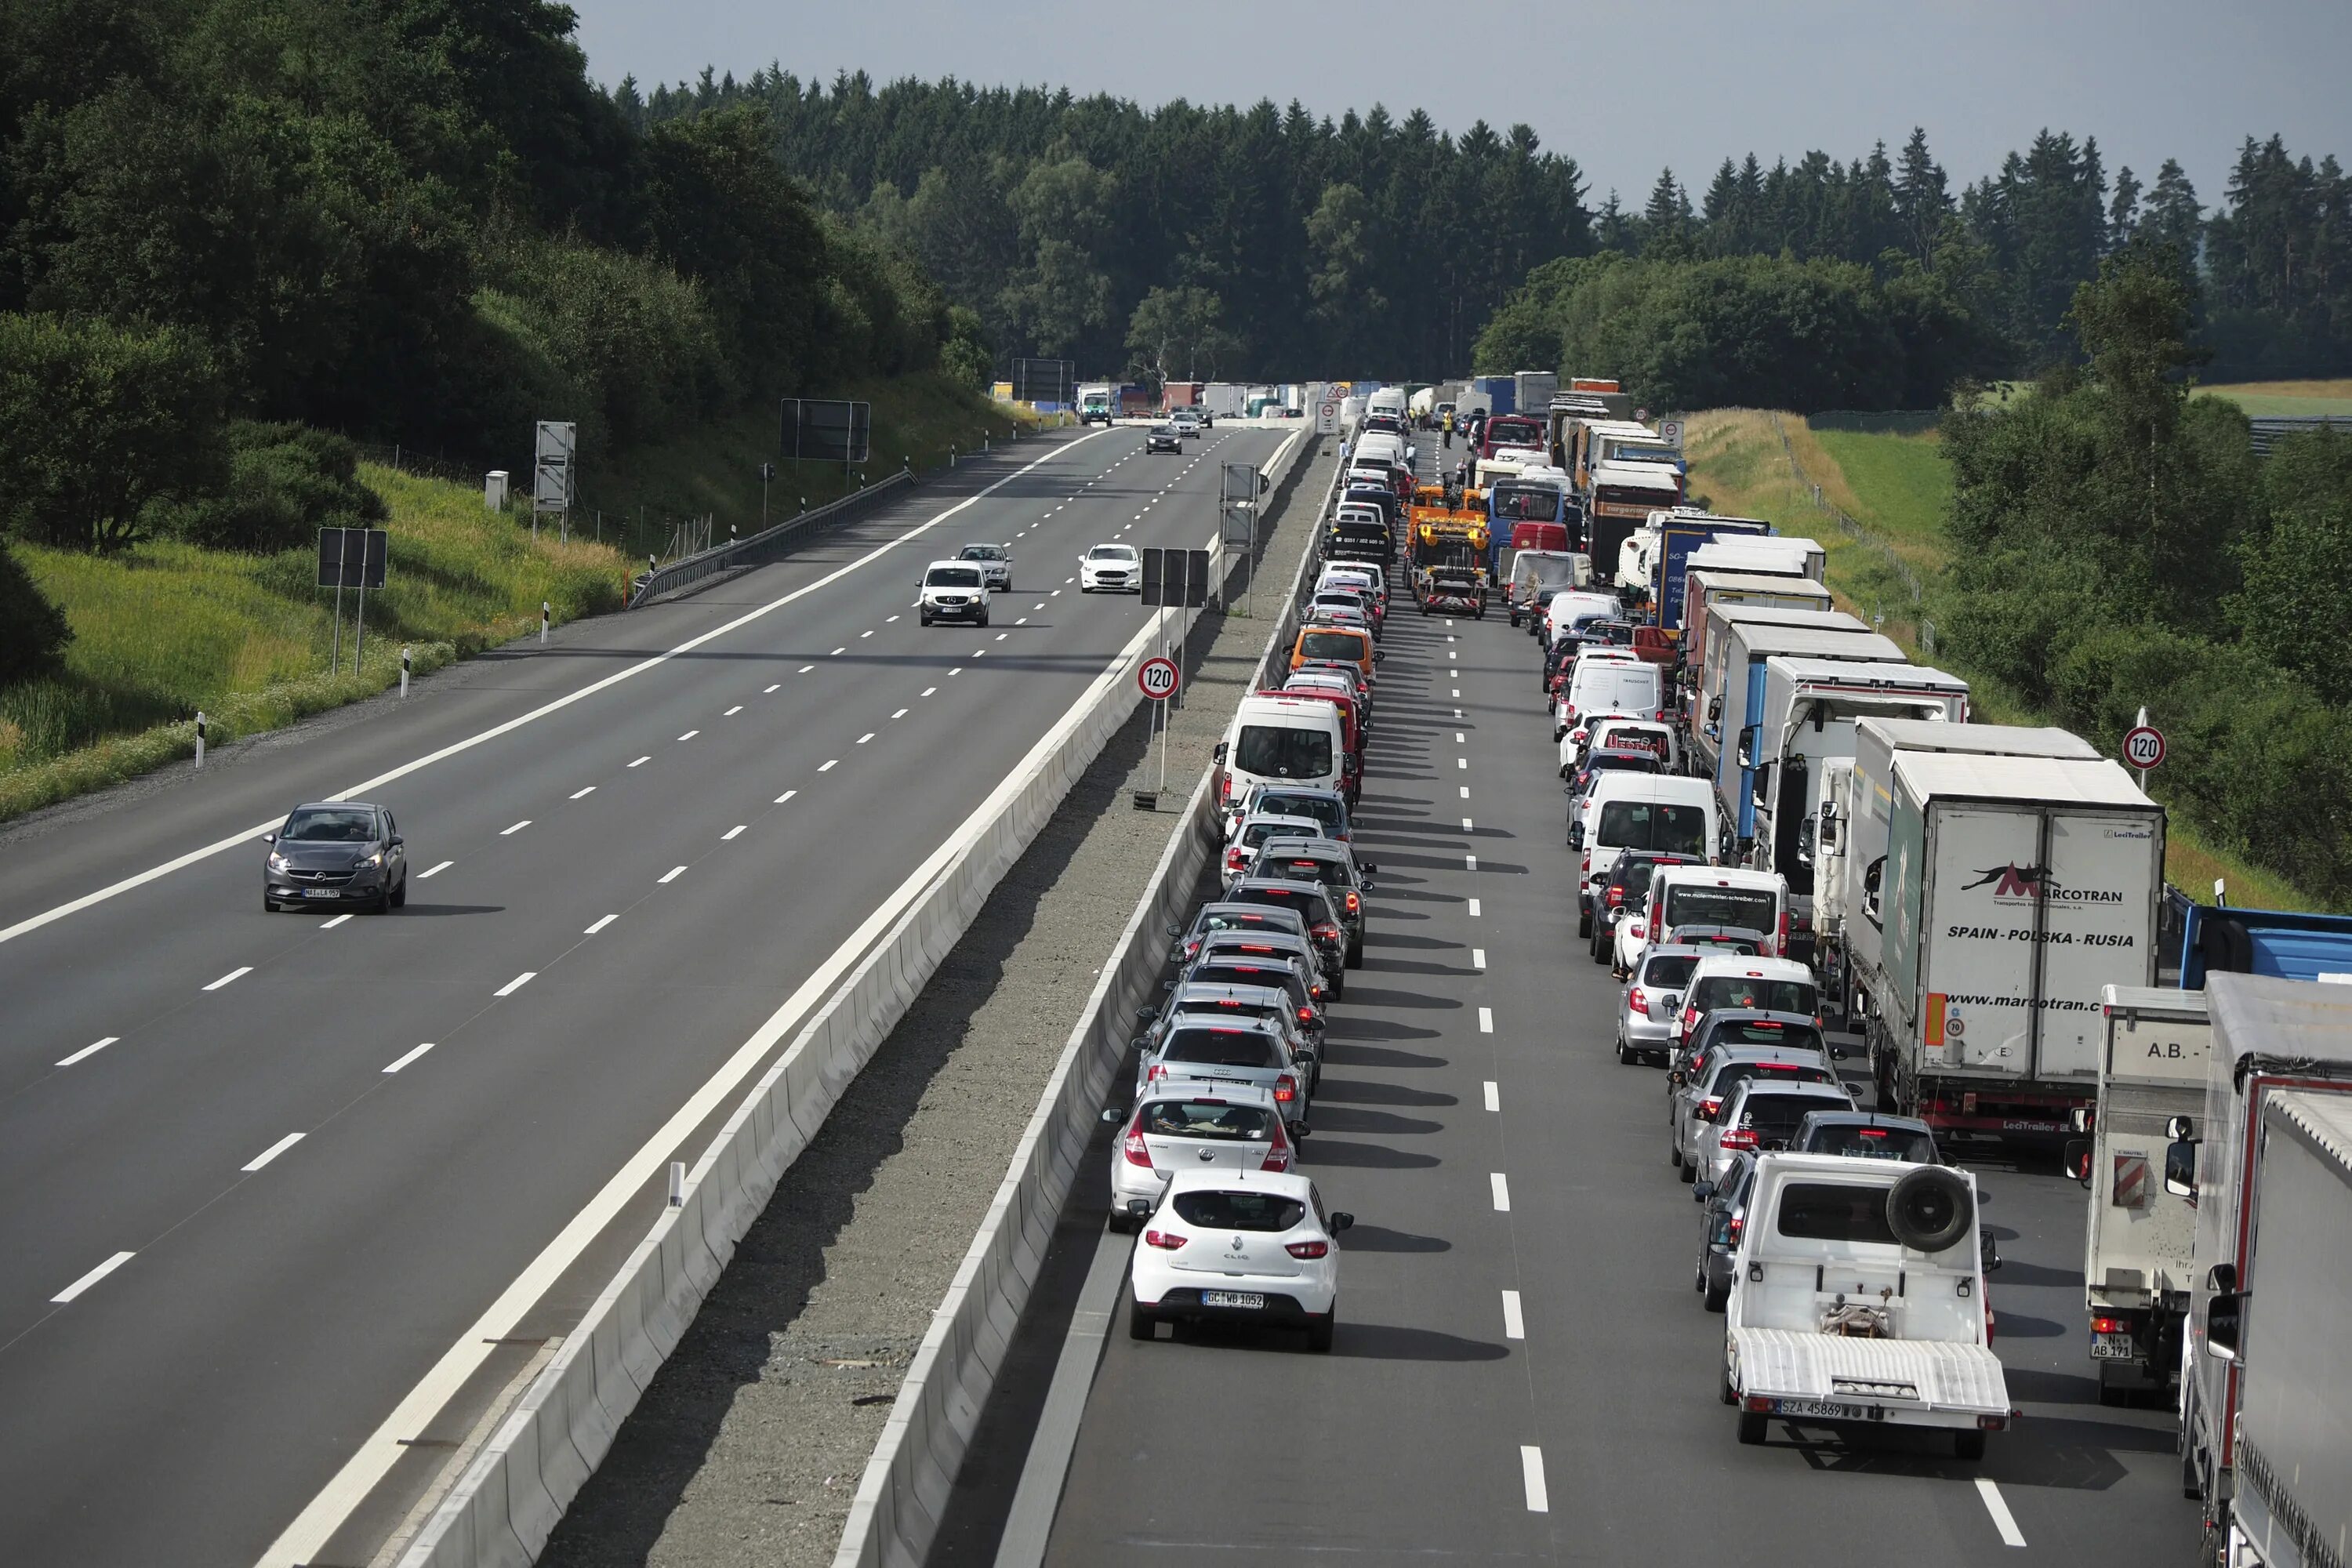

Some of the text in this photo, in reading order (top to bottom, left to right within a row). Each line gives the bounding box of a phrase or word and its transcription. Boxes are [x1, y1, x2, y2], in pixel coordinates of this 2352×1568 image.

[1147, 668, 1171, 688] 120
[2132, 738, 2157, 758] 120
[1947, 926, 1998, 939] SPAIN
[2008, 929, 2072, 944] POLSKA
[2083, 934, 2133, 947] RUSIA
[2000, 1047, 2007, 1057] E
[2147, 1042, 2186, 1059] A.B.
[2003, 1120, 2056, 1131] LeciTrailer
[1208, 1291, 1262, 1306] GC WB 1052
[2109, 1334, 2116, 1345] N
[2093, 1345, 2130, 1357] AB 171
[1782, 1401, 1842, 1417] SZA 45869
